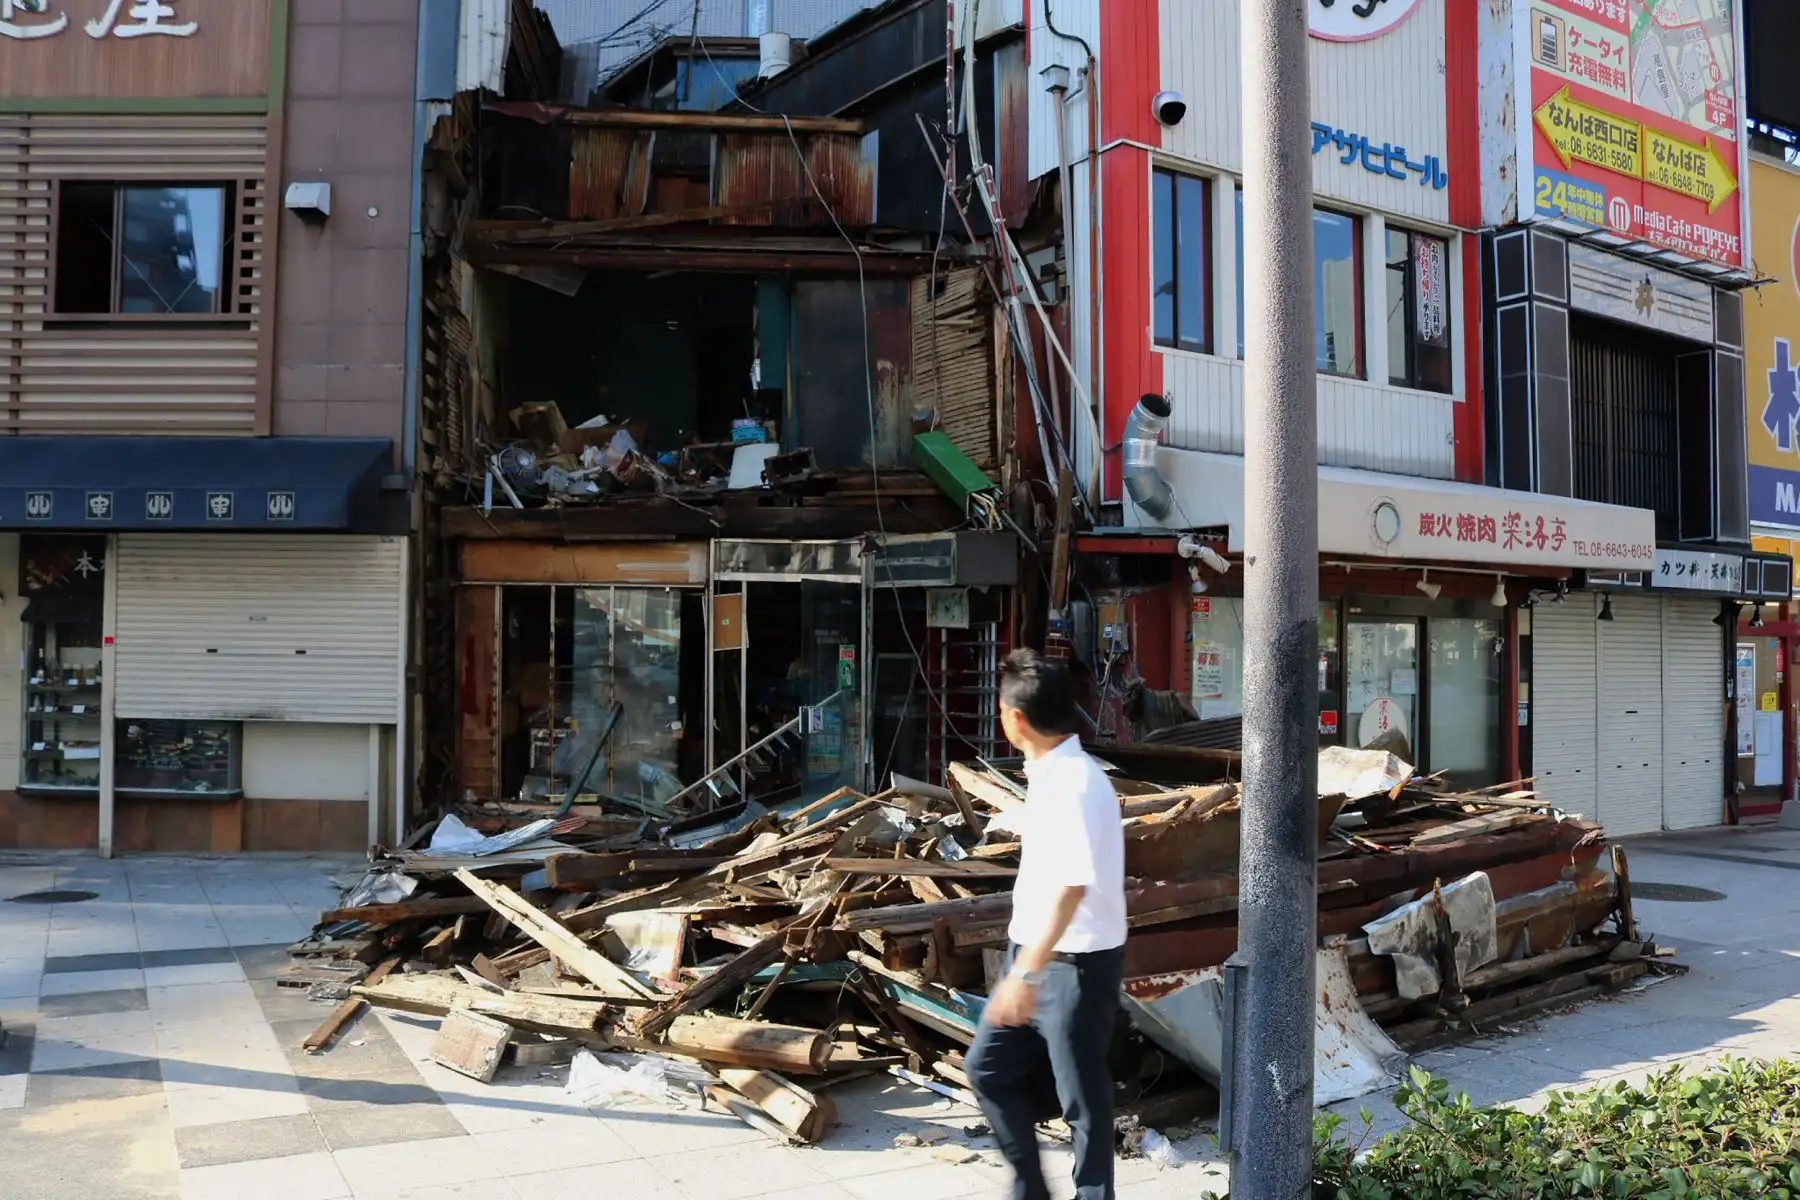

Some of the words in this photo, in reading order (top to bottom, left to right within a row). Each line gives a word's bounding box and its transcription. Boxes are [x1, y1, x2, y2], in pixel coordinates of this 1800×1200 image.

[1568, 25, 1625, 65] ケータイ
[1568, 51, 1626, 93] 充電無料
[1548, 103, 1637, 153] なんば西口店
[1311, 122, 1447, 190] アサヒビール
[1652, 138, 1706, 177] なんば店
[1535, 176, 1568, 213] 24
[1633, 204, 1665, 233] Media
[1666, 212, 1691, 238] Cafe
[1693, 223, 1740, 253] POPEYE
[1775, 482, 1800, 514] M
[1418, 512, 1497, 544] 炭火焼肉
[74, 551, 106, 579] 本
[1572, 540, 1589, 557] TEL
[1590, 541, 1653, 560] 06-6643-6045
